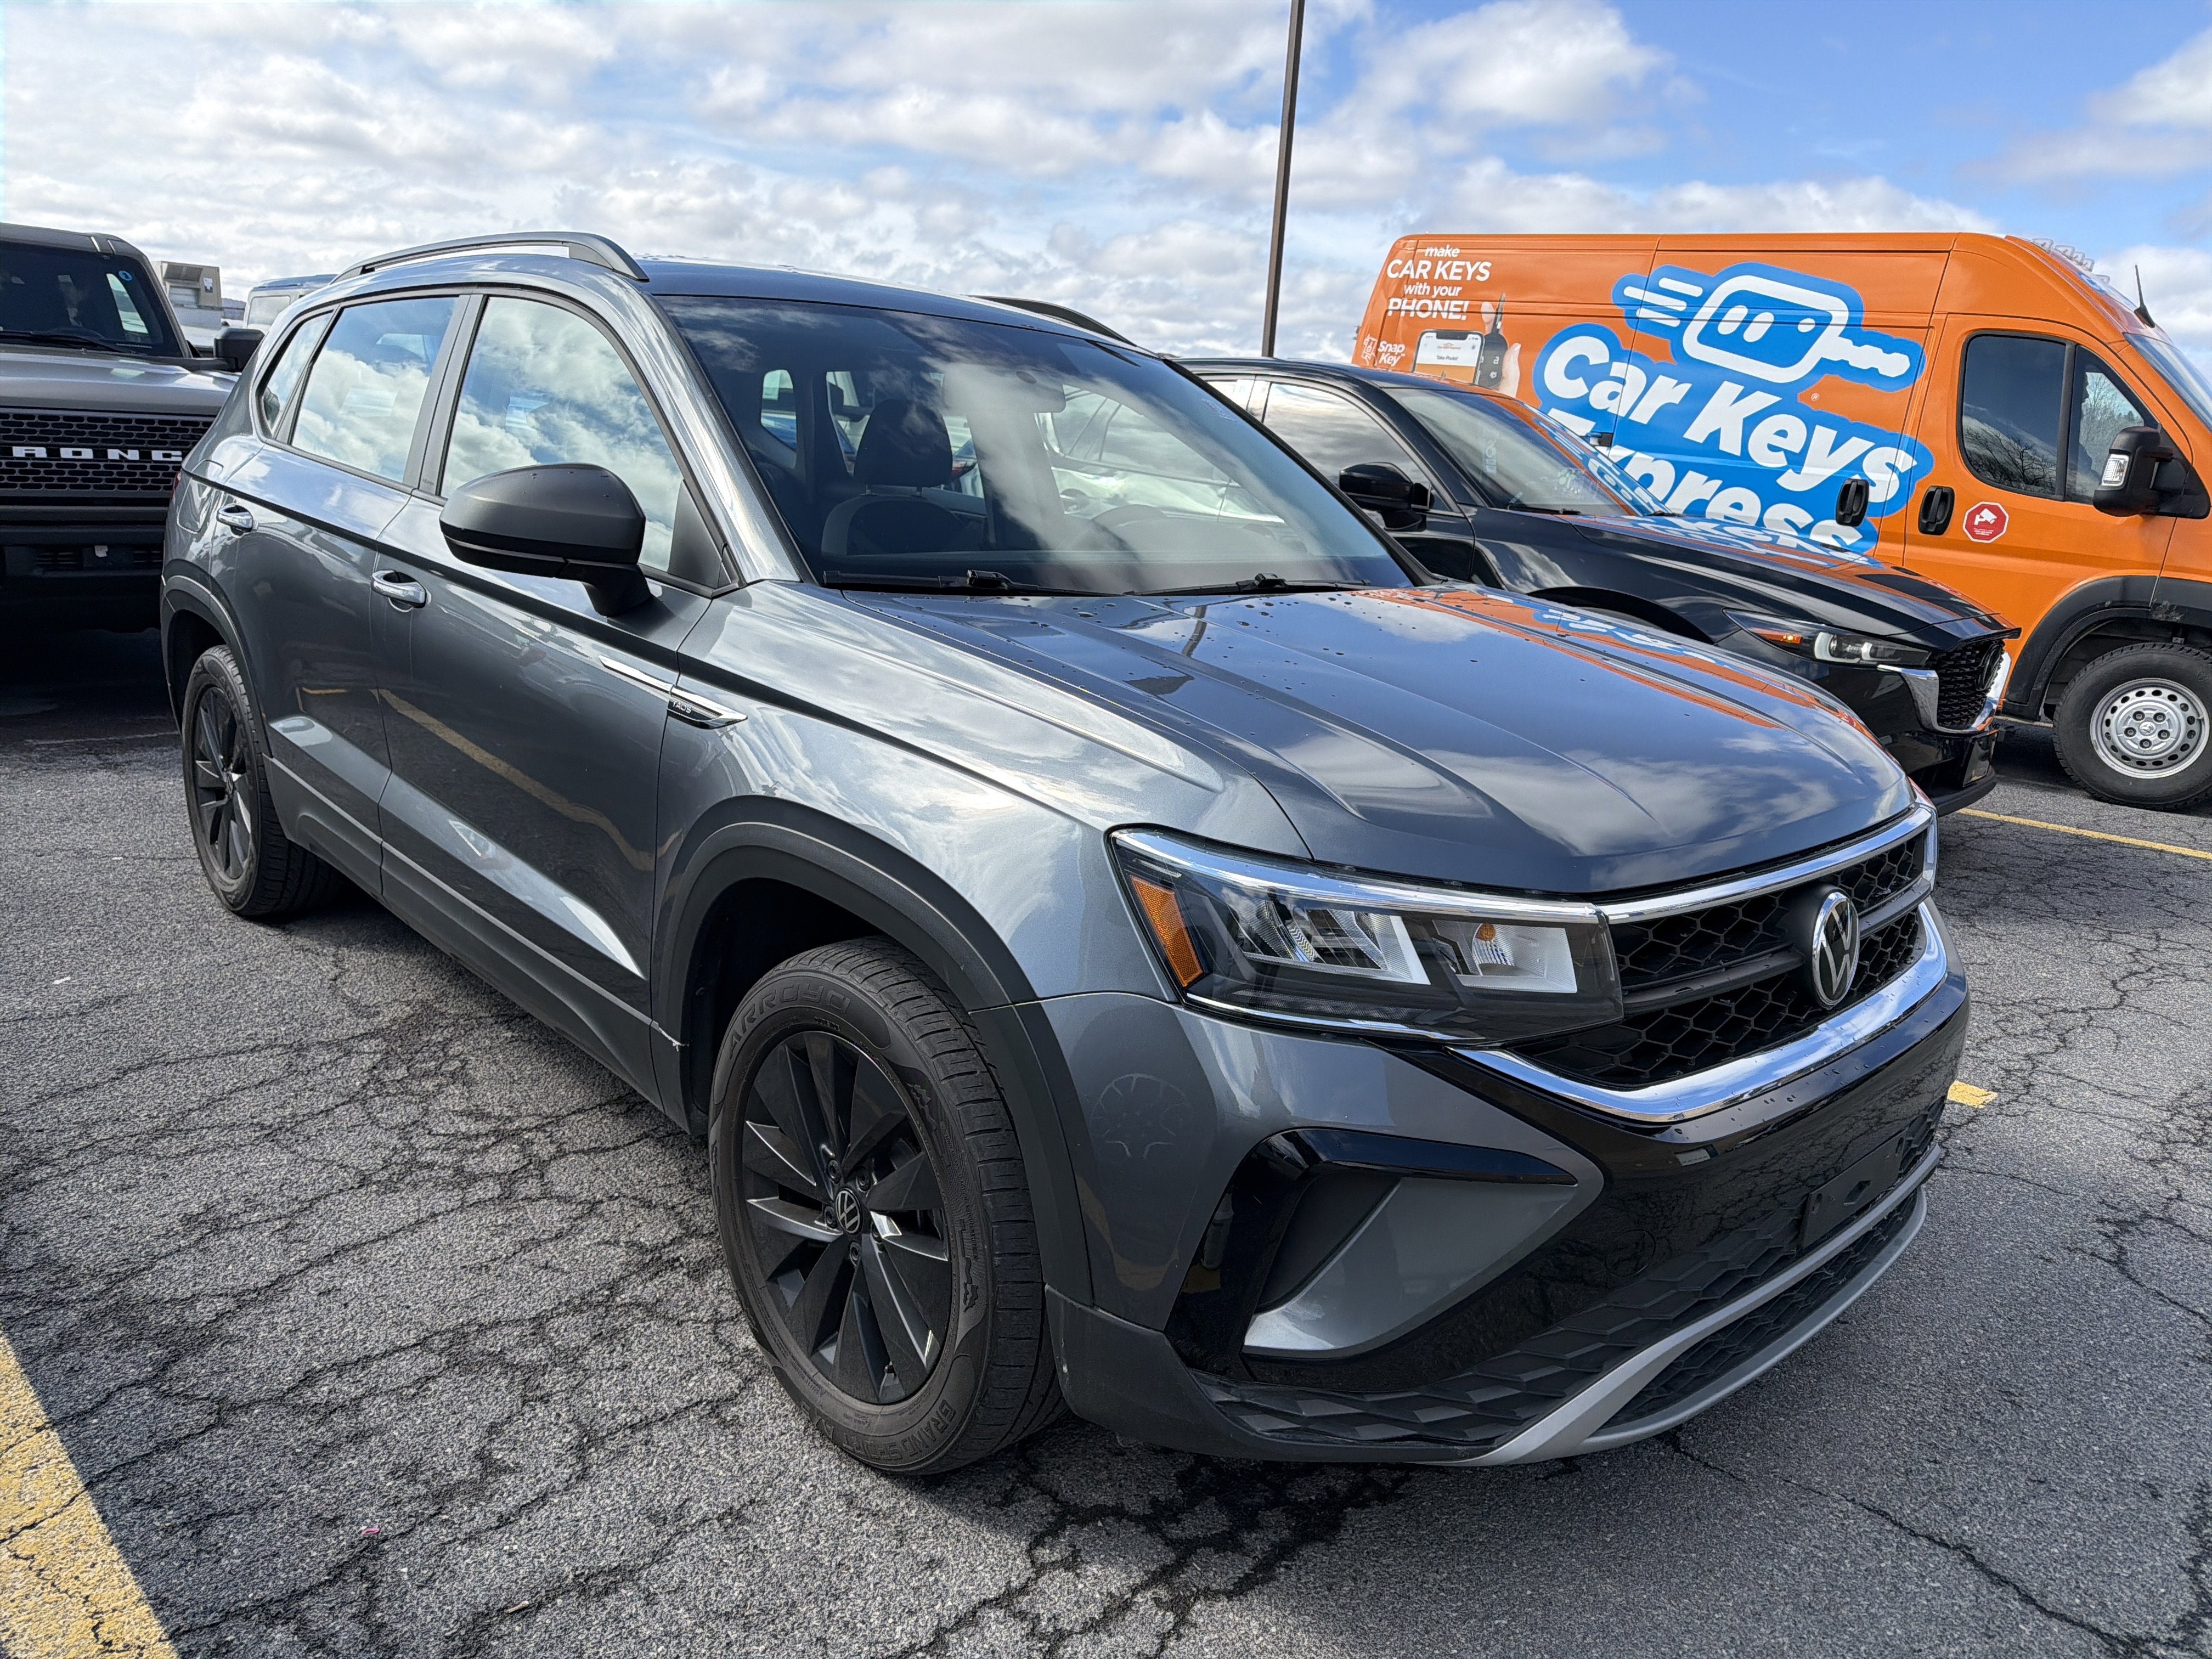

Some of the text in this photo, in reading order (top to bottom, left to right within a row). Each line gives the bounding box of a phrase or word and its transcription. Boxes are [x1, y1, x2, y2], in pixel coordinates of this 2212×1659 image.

[1425, 244, 1460, 257] make
[1387, 259, 1492, 281] CAR KEYS
[1404, 281, 1462, 298] with your
[1387, 297, 1470, 321] PHONE!
[1378, 341, 1405, 354] Snap
[1379, 352, 1401, 367] Key
[1543, 335, 1917, 504] Car Keys
[12, 445, 183, 461] RONC
[1547, 408, 1864, 548] press
[672, 699, 693, 714] TAOS
